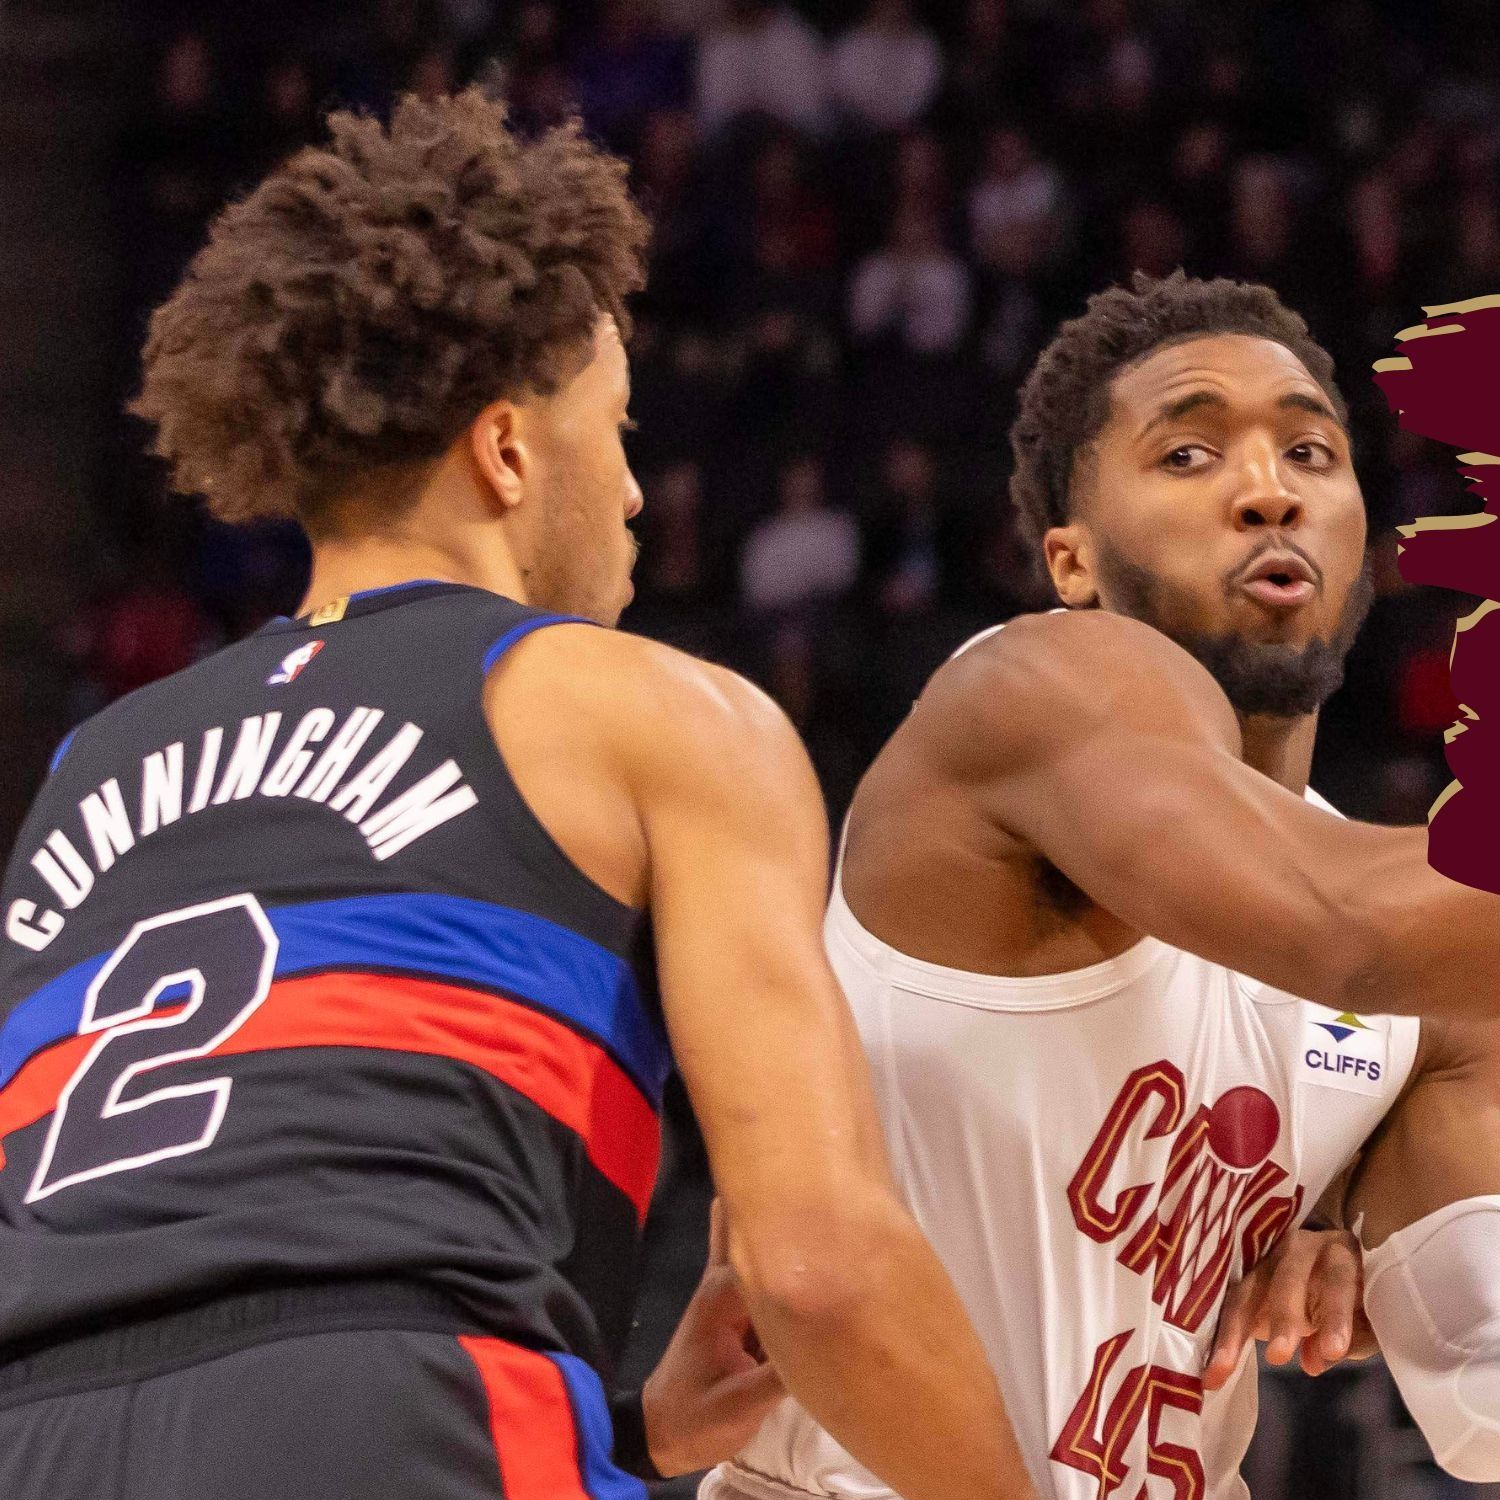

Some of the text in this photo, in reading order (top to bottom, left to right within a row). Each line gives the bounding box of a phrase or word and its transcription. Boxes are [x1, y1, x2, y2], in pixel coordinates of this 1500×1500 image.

[5, 706, 479, 951] CUNNINGHAM
[24, 891, 280, 1204] 2
[1305, 1048, 1381, 1081] CLIFFS
